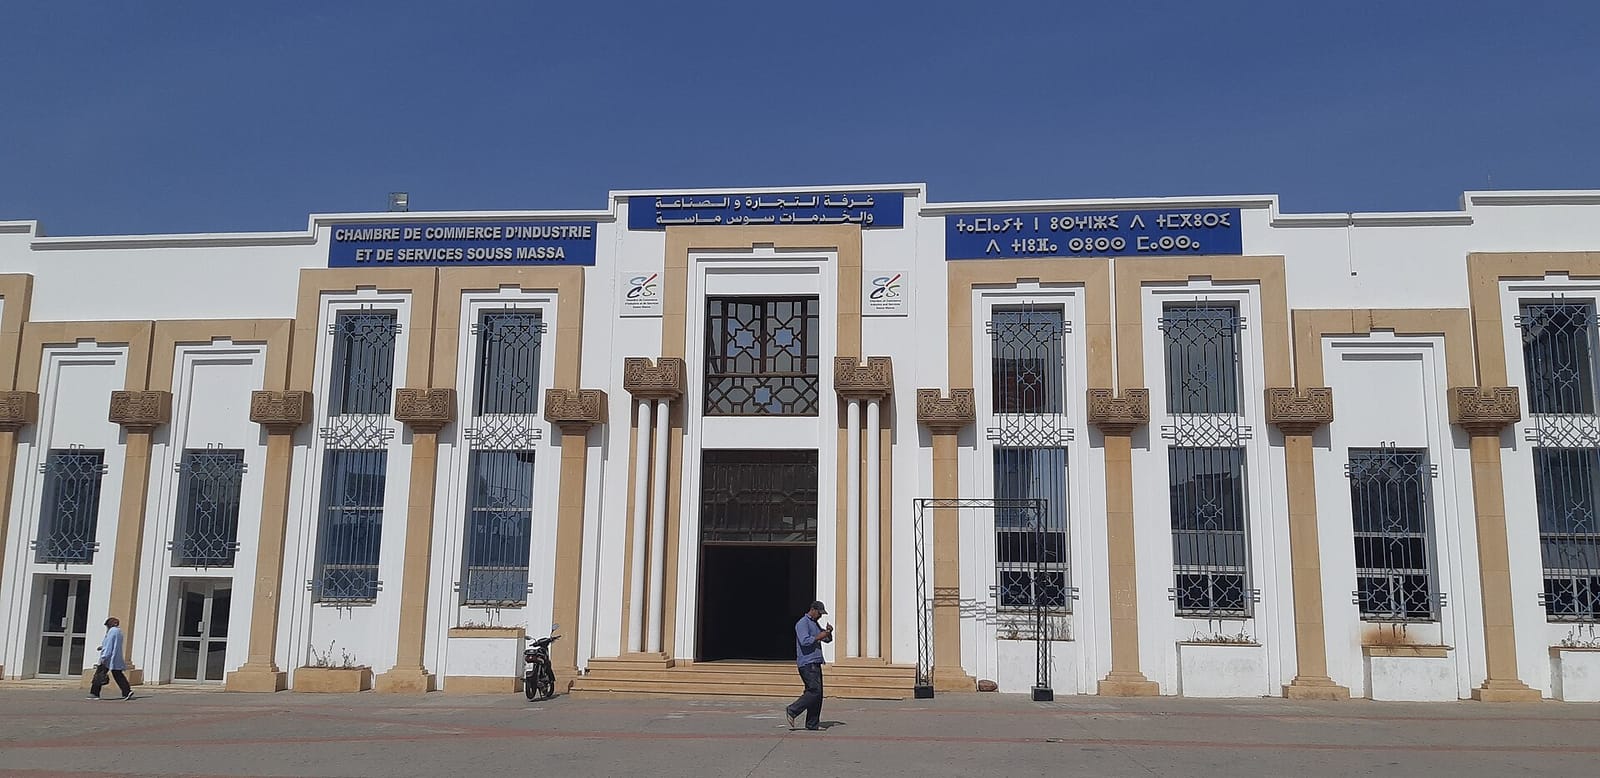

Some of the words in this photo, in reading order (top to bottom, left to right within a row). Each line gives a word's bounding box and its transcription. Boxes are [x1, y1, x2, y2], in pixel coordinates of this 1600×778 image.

[655, 196, 730, 208] الصناعة
[734, 198, 741, 209] و
[745, 195, 820, 209] التجارة
[823, 193, 874, 208] غرفة
[656, 211, 722, 224] ماسة
[726, 214, 775, 225] سوس
[779, 209, 874, 224] والخدمات
[335, 227, 400, 241] CHAMBRE
[403, 227, 422, 240] DE
[425, 226, 502, 240] COMMERCE
[505, 225, 592, 239] D'INDUSTRIE
[355, 249, 373, 261] ET
[376, 248, 394, 261] DE
[397, 248, 463, 260] SERVICES
[466, 247, 513, 260] SOUSS
[516, 246, 565, 259] MASSA
